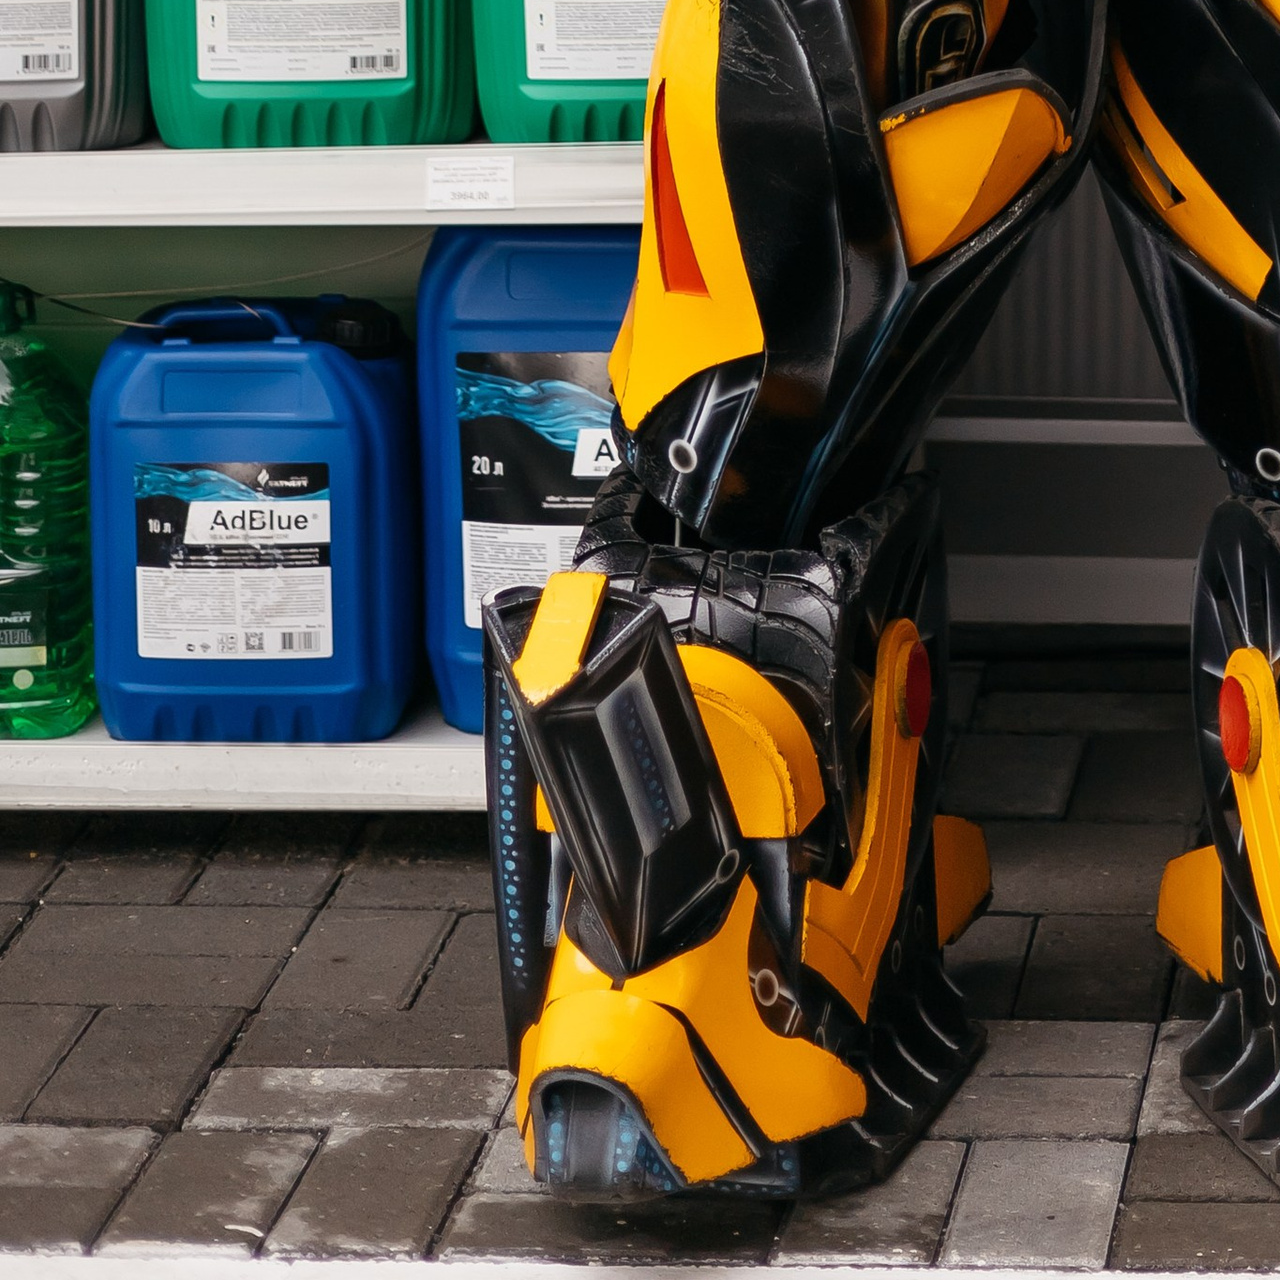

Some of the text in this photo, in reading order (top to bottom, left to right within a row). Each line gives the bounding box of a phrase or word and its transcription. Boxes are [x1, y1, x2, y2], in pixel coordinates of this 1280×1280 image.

[472, 455, 504, 476] 20 л
[148, 519, 161, 533] 10
[210, 510, 309, 531] AdBlue
